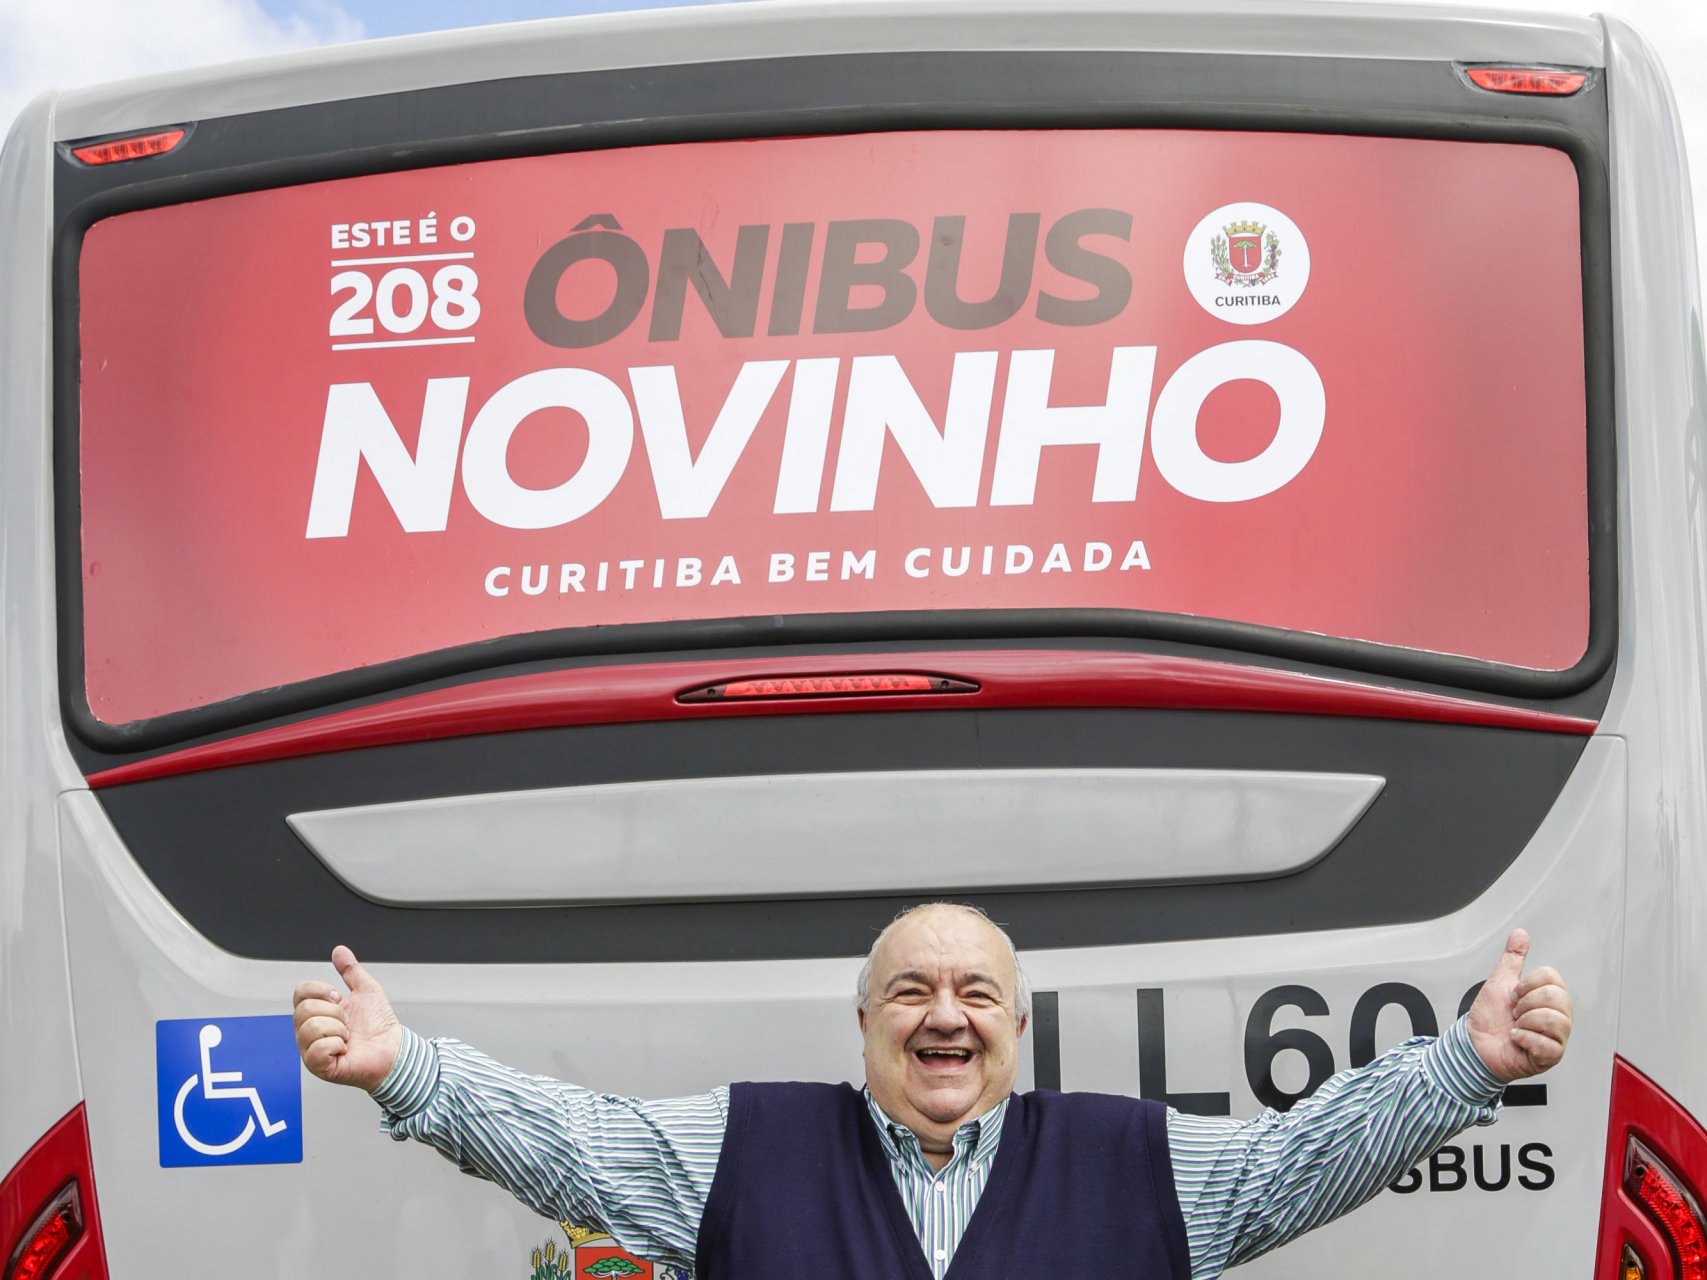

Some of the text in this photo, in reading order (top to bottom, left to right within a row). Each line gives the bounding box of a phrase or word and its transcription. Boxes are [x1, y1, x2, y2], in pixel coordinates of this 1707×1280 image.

[331, 211, 476, 249] ESTE É O
[329, 264, 481, 337] 208
[523, 207, 1134, 349] ÔNIBUS
[1214, 295, 1281, 307] CURITIBA
[305, 339, 1326, 539] NOVINHO
[484, 540, 1151, 597] CURITIBA BEM CUIDADA
